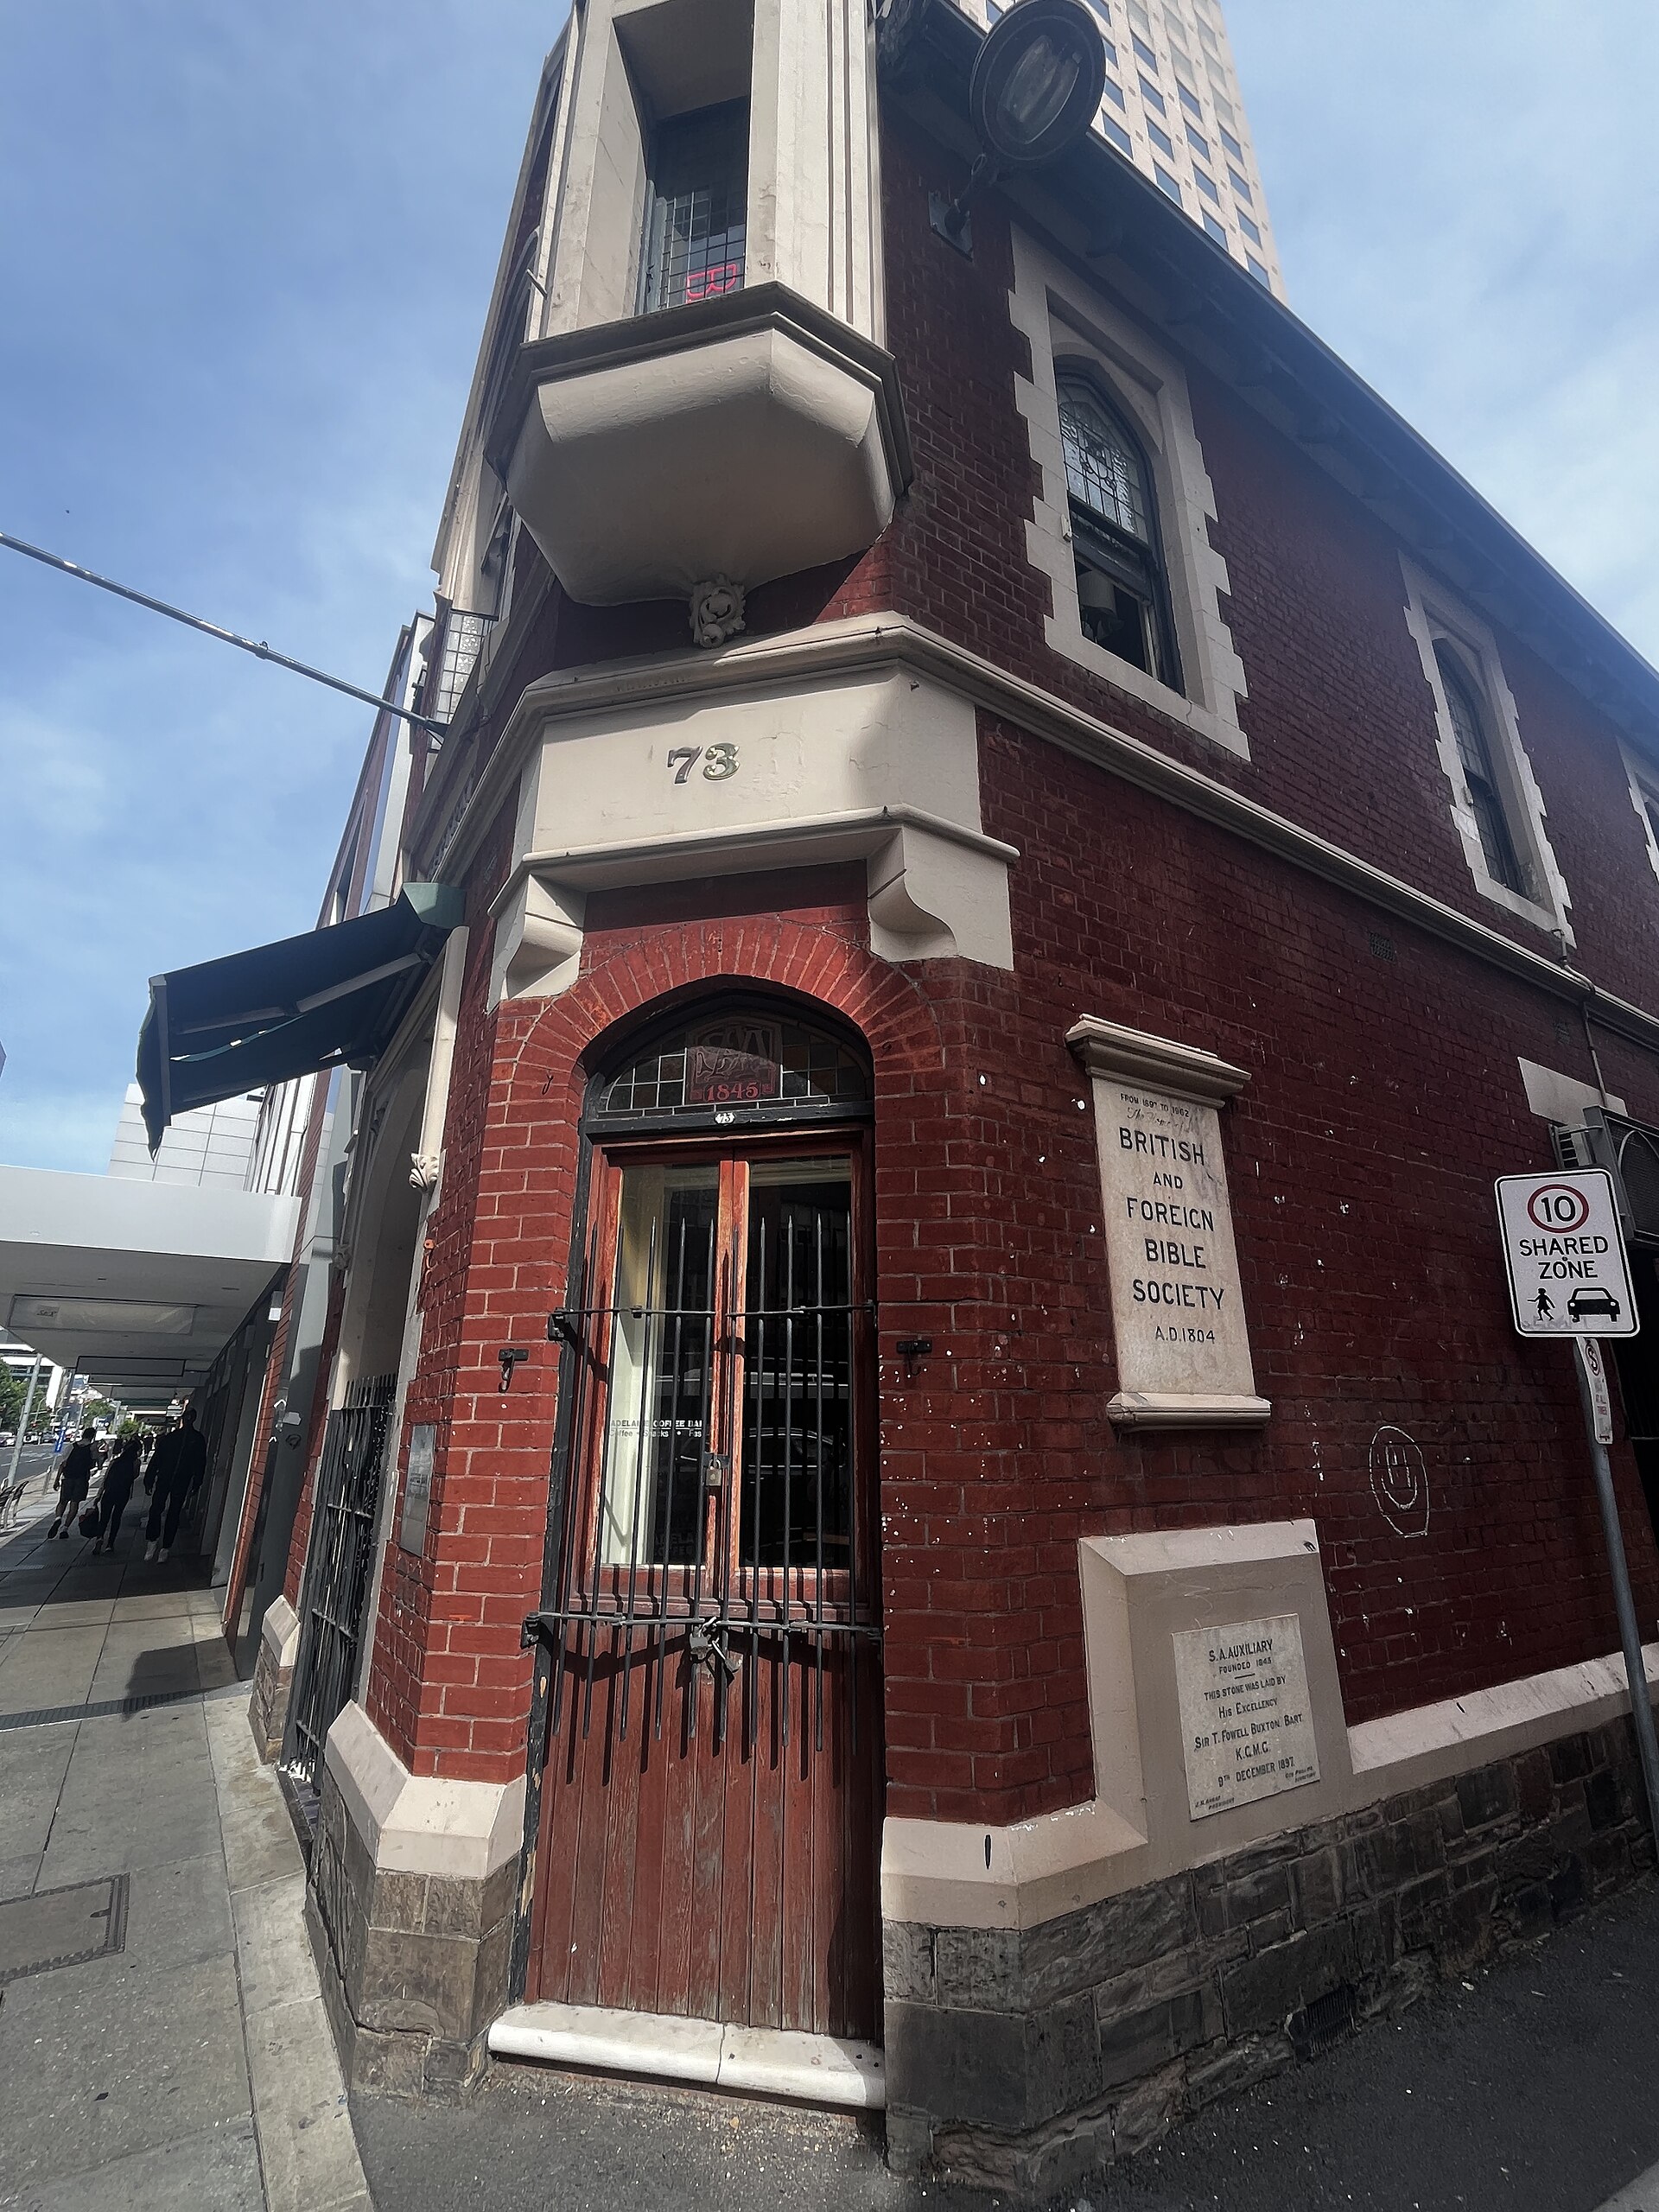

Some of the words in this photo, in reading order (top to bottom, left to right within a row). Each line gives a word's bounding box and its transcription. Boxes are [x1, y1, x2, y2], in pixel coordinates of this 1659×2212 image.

[668, 743, 741, 784] 73
[707, 1083, 759, 1101] 1845
[1120, 1093, 1140, 1104] FROM
[1172, 1107, 1190, 1117] 1962
[1119, 1127, 1205, 1166] BRITISH
[1154, 1172, 1183, 1190] AND
[1127, 1197, 1214, 1232] FOREIGN
[1541, 1195, 1576, 1223] 10
[1145, 1238, 1206, 1268] BIBLE
[1520, 1236, 1609, 1256] SHARED
[1538, 1261, 1599, 1279] ZONE
[1133, 1279, 1224, 1310] SOCIETY
[1218, 1661, 1252, 1675] FOUNDED
[1204, 1689, 1221, 1701] THIS
[1222, 1684, 1244, 1697] STONE
[1245, 1681, 1260, 1691] WAS
[1261, 1677, 1275, 1688] LAID
[1276, 1675, 1287, 1685] BY
[1236, 1763, 1275, 1782] DECEMBER
